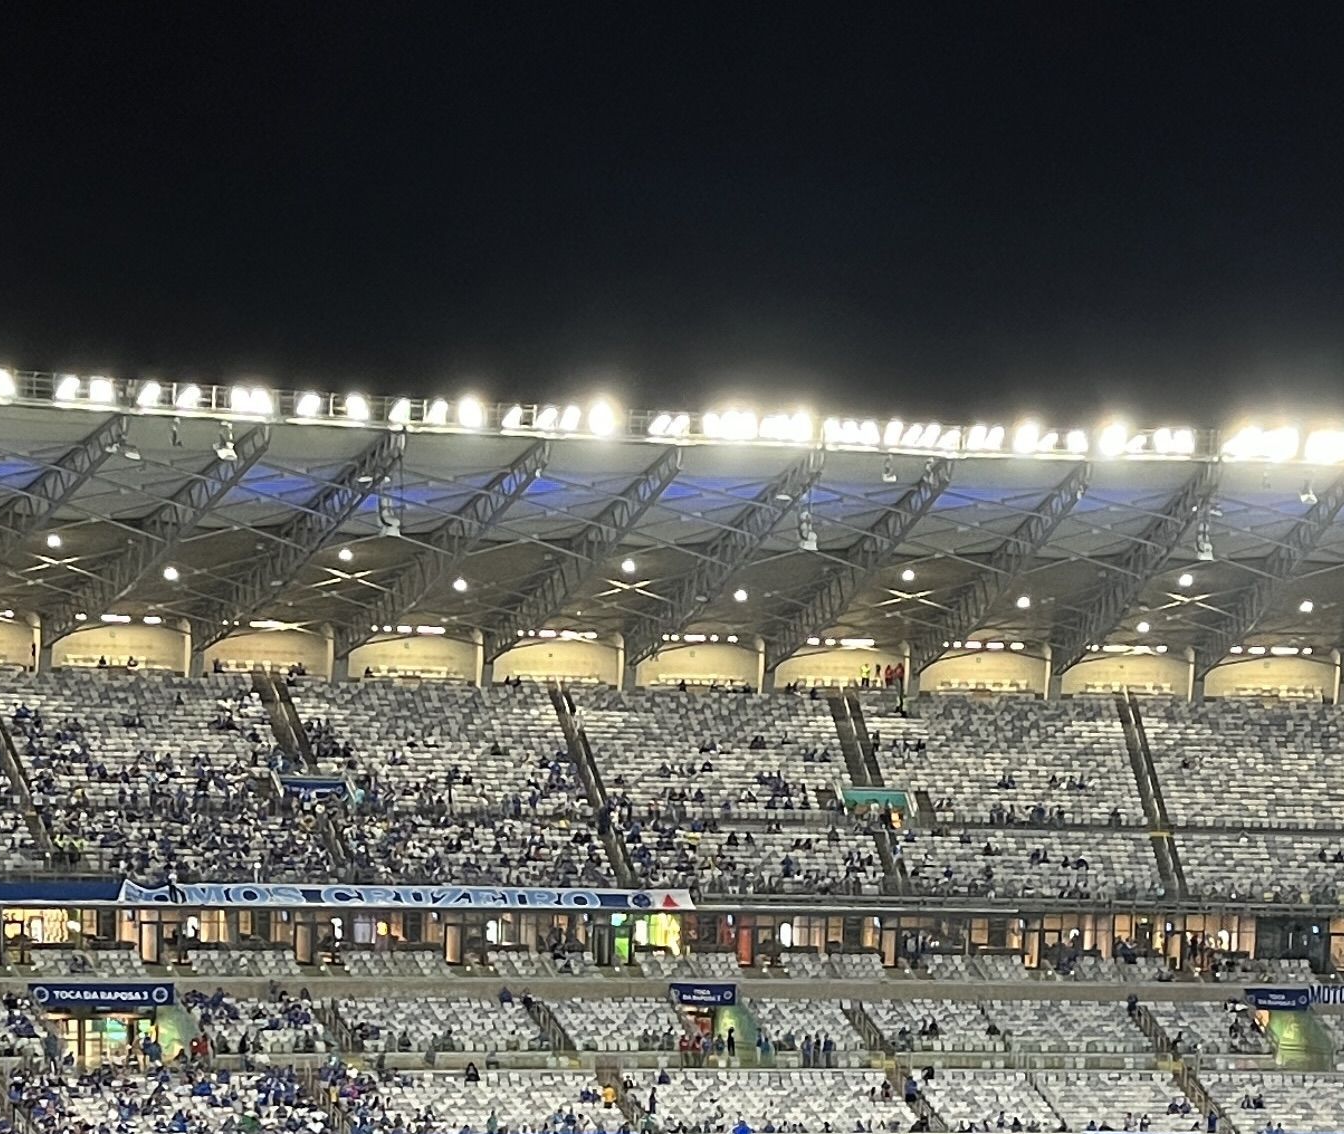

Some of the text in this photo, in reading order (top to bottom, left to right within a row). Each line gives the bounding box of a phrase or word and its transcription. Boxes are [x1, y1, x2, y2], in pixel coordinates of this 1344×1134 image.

[320, 887, 602, 908] CRUZEIRO
[53, 990, 82, 999] TOCA
[84, 991, 98, 999] DA
[100, 991, 141, 1000] RAPOSA
